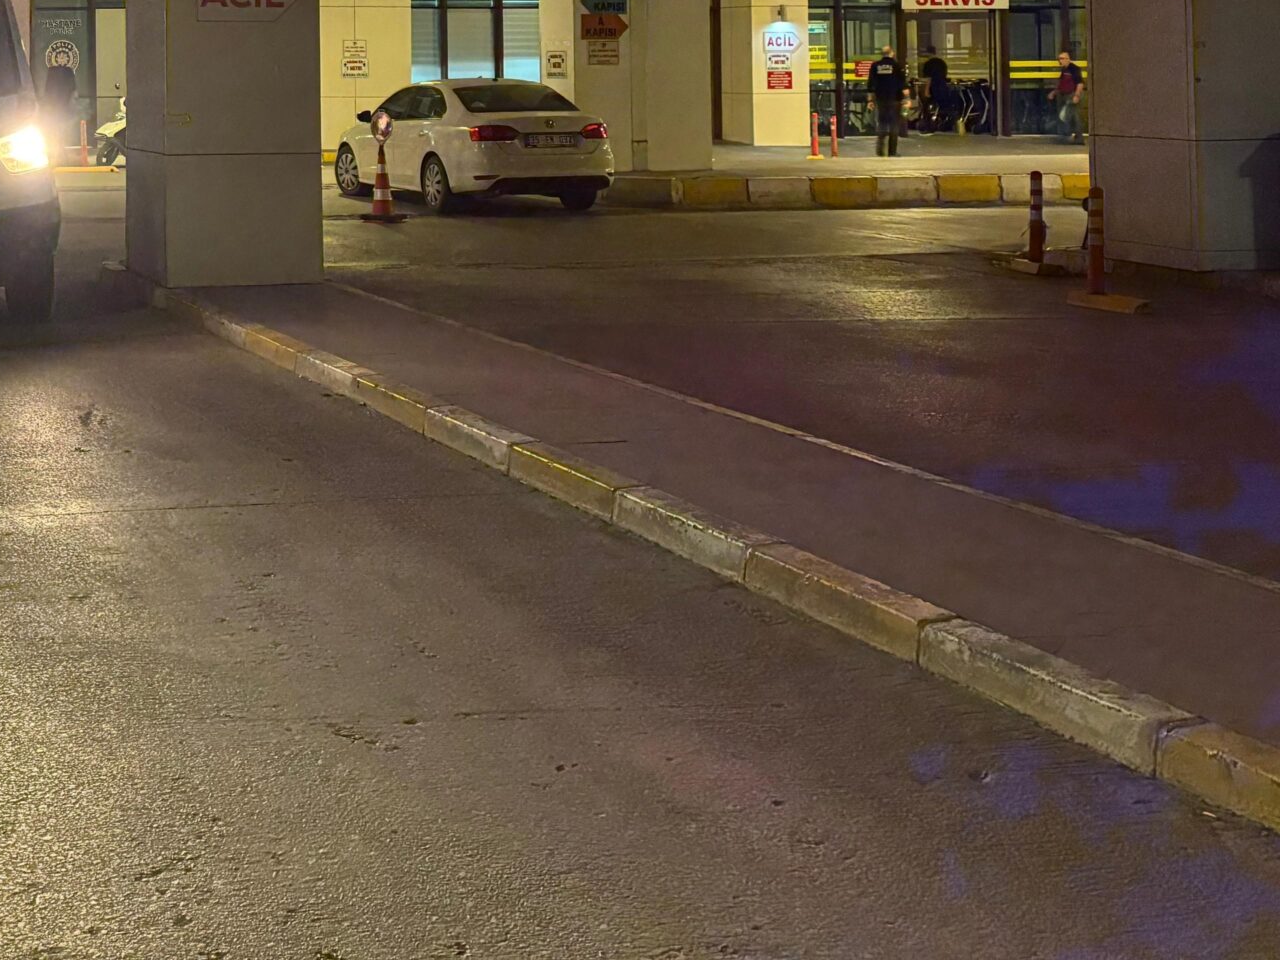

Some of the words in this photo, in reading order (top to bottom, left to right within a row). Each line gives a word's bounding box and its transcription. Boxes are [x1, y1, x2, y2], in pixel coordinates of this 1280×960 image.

[598, 15, 605, 25] A
[585, 27, 617, 37] KAPISI
[767, 33, 794, 47] ACİL
